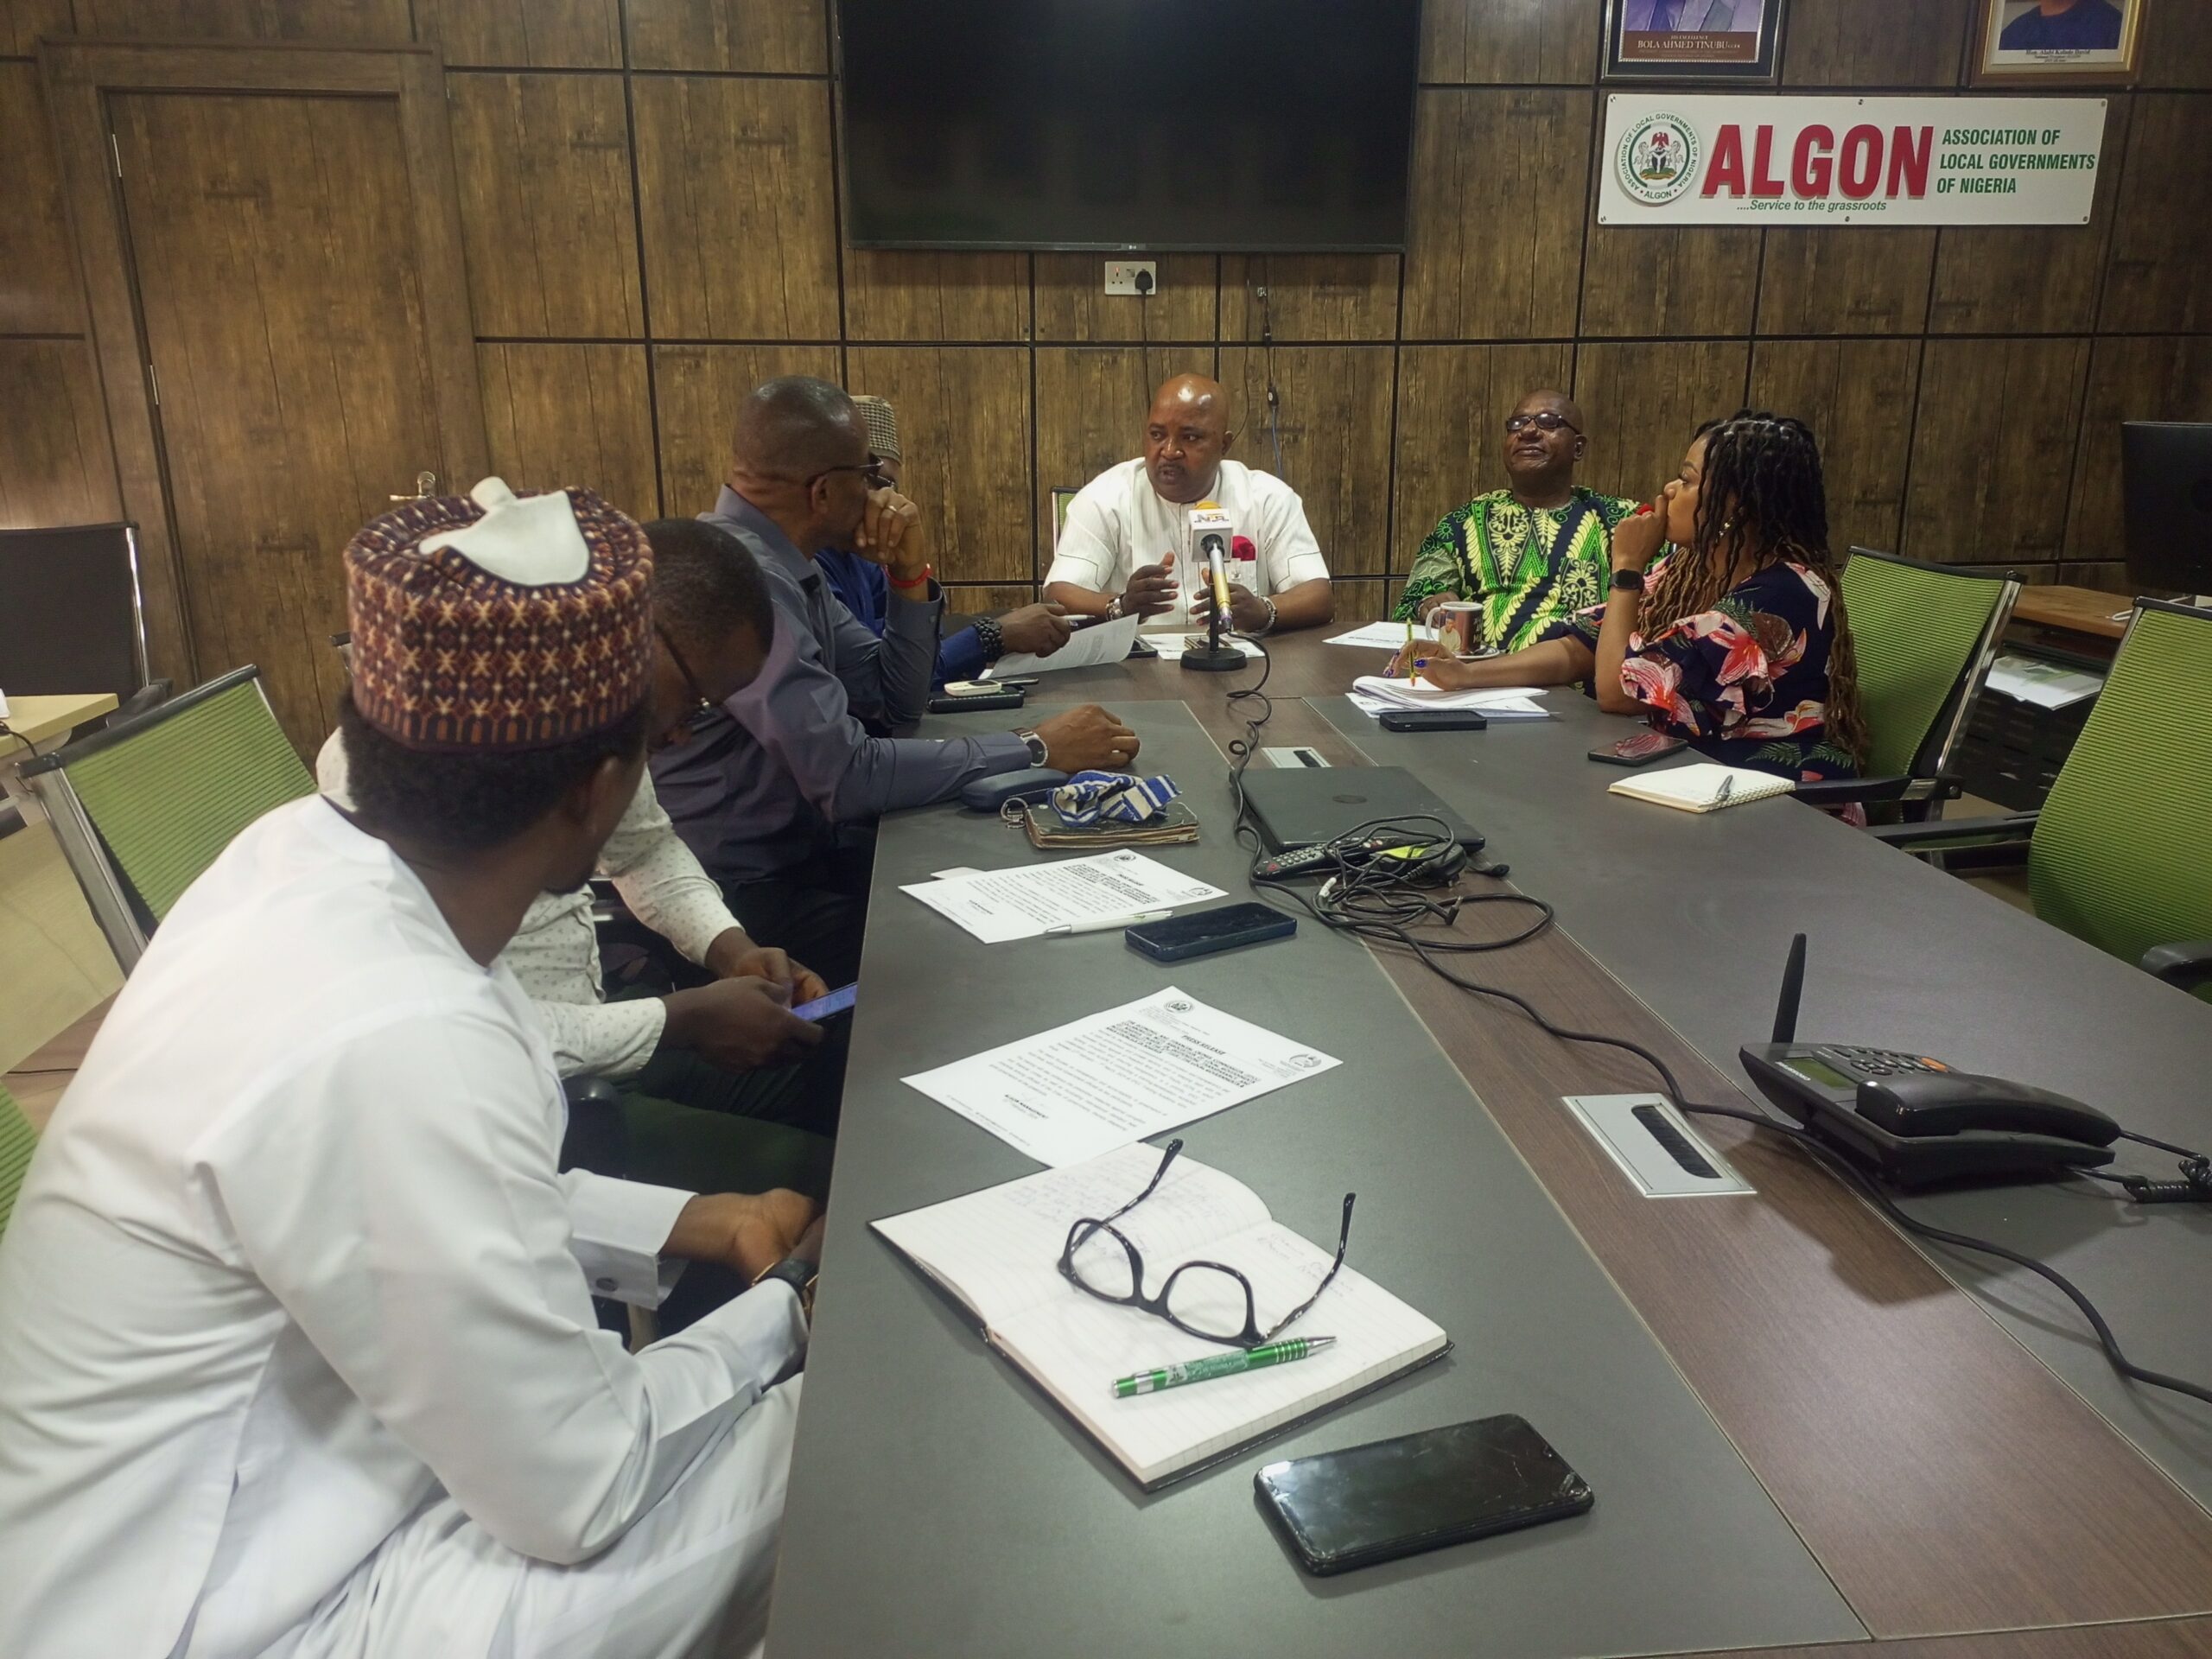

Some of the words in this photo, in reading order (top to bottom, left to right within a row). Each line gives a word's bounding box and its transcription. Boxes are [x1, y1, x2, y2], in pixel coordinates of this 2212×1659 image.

[1632, 116, 1654, 132] LOCAL
[1656, 113, 1697, 145] GOVERNMENTS
[1625, 132, 1634, 143] OF
[1942, 129, 2037, 145] ASSOCIATION
[2041, 130, 2061, 145] OF
[1692, 147, 1698, 157] OF
[1621, 144, 1640, 190] ASSOCIATION
[1700, 124, 1935, 198] ALGON
[1940, 154, 1984, 169] LOCAL
[1989, 154, 2095, 169] GOVERNMENTS
[1677, 159, 1697, 188] NIGERIA
[1936, 178, 1956, 194] OF
[1960, 178, 2017, 194] NIGERIA
[1643, 190, 1672, 200] ALGON
[1794, 200, 1805, 211] to
[1808, 200, 1826, 211] the
[1827, 201, 1887, 213] grassroots
